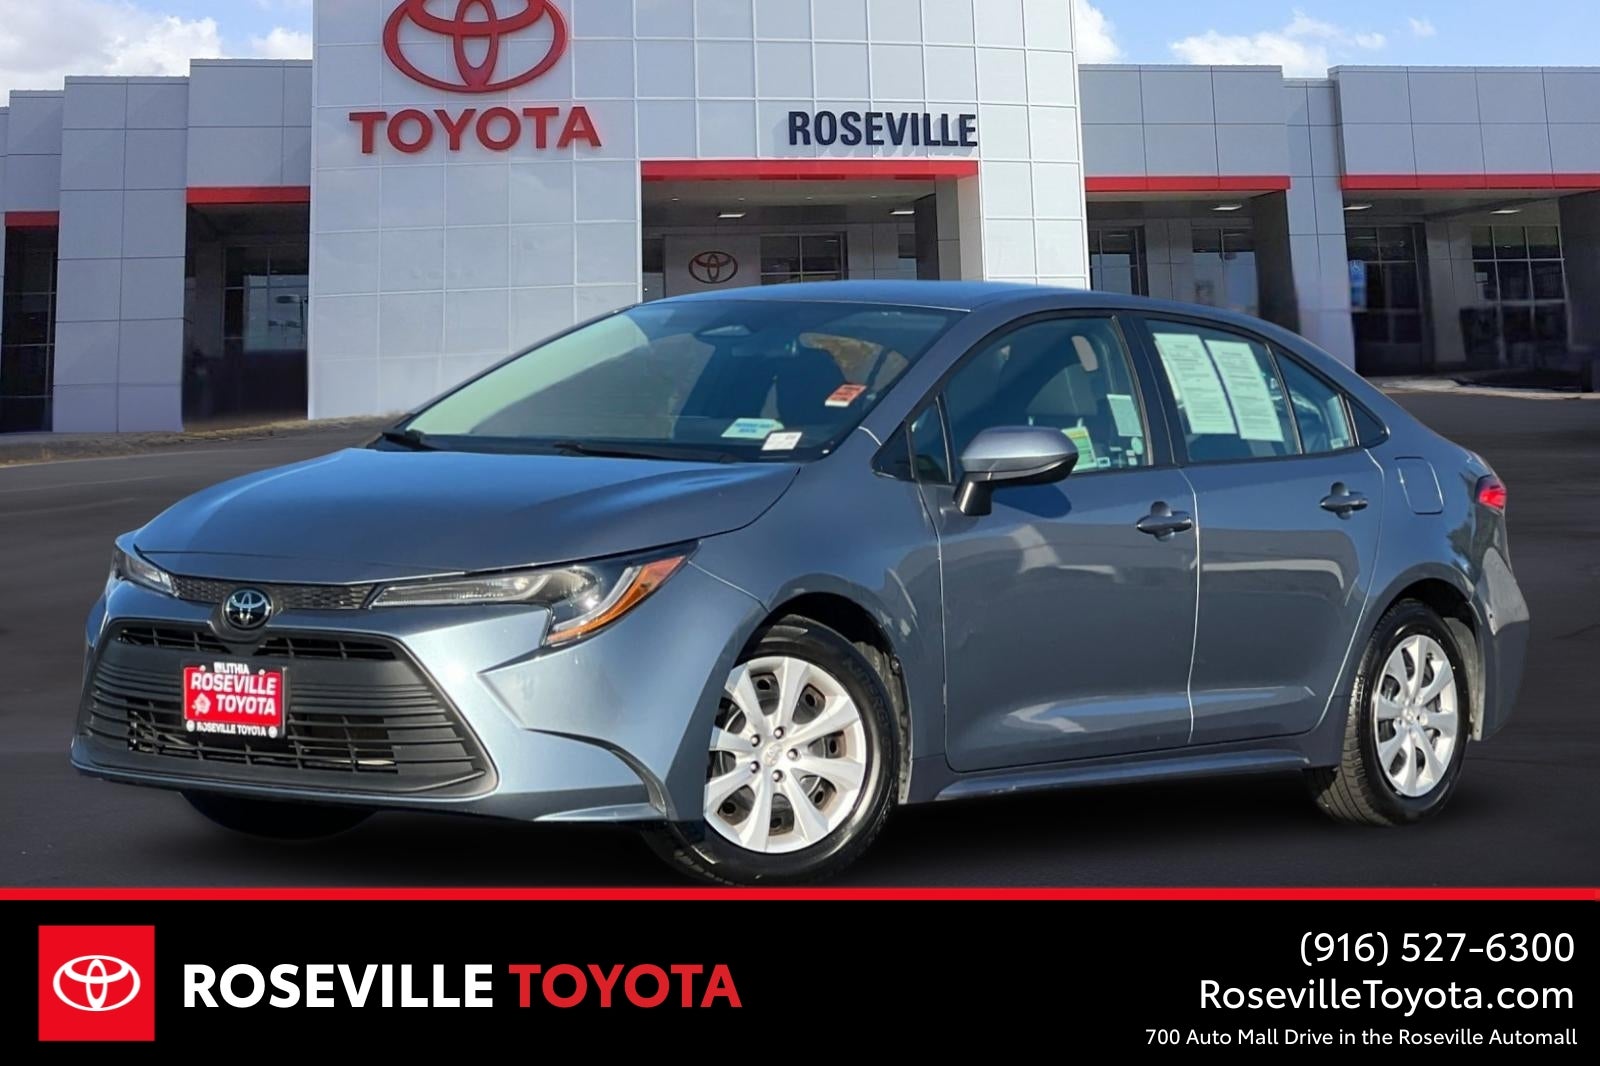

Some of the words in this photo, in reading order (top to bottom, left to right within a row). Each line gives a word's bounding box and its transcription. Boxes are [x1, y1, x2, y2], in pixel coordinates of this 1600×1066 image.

[349, 106, 602, 154] TOYOTA
[788, 110, 978, 147] ROSEVILLE
[191, 672, 277, 695] ROSEVILLE
[216, 694, 276, 716] TOYOTA
[196, 722, 236, 733] ROSEVILLE
[237, 725, 266, 736] TOYOTA
